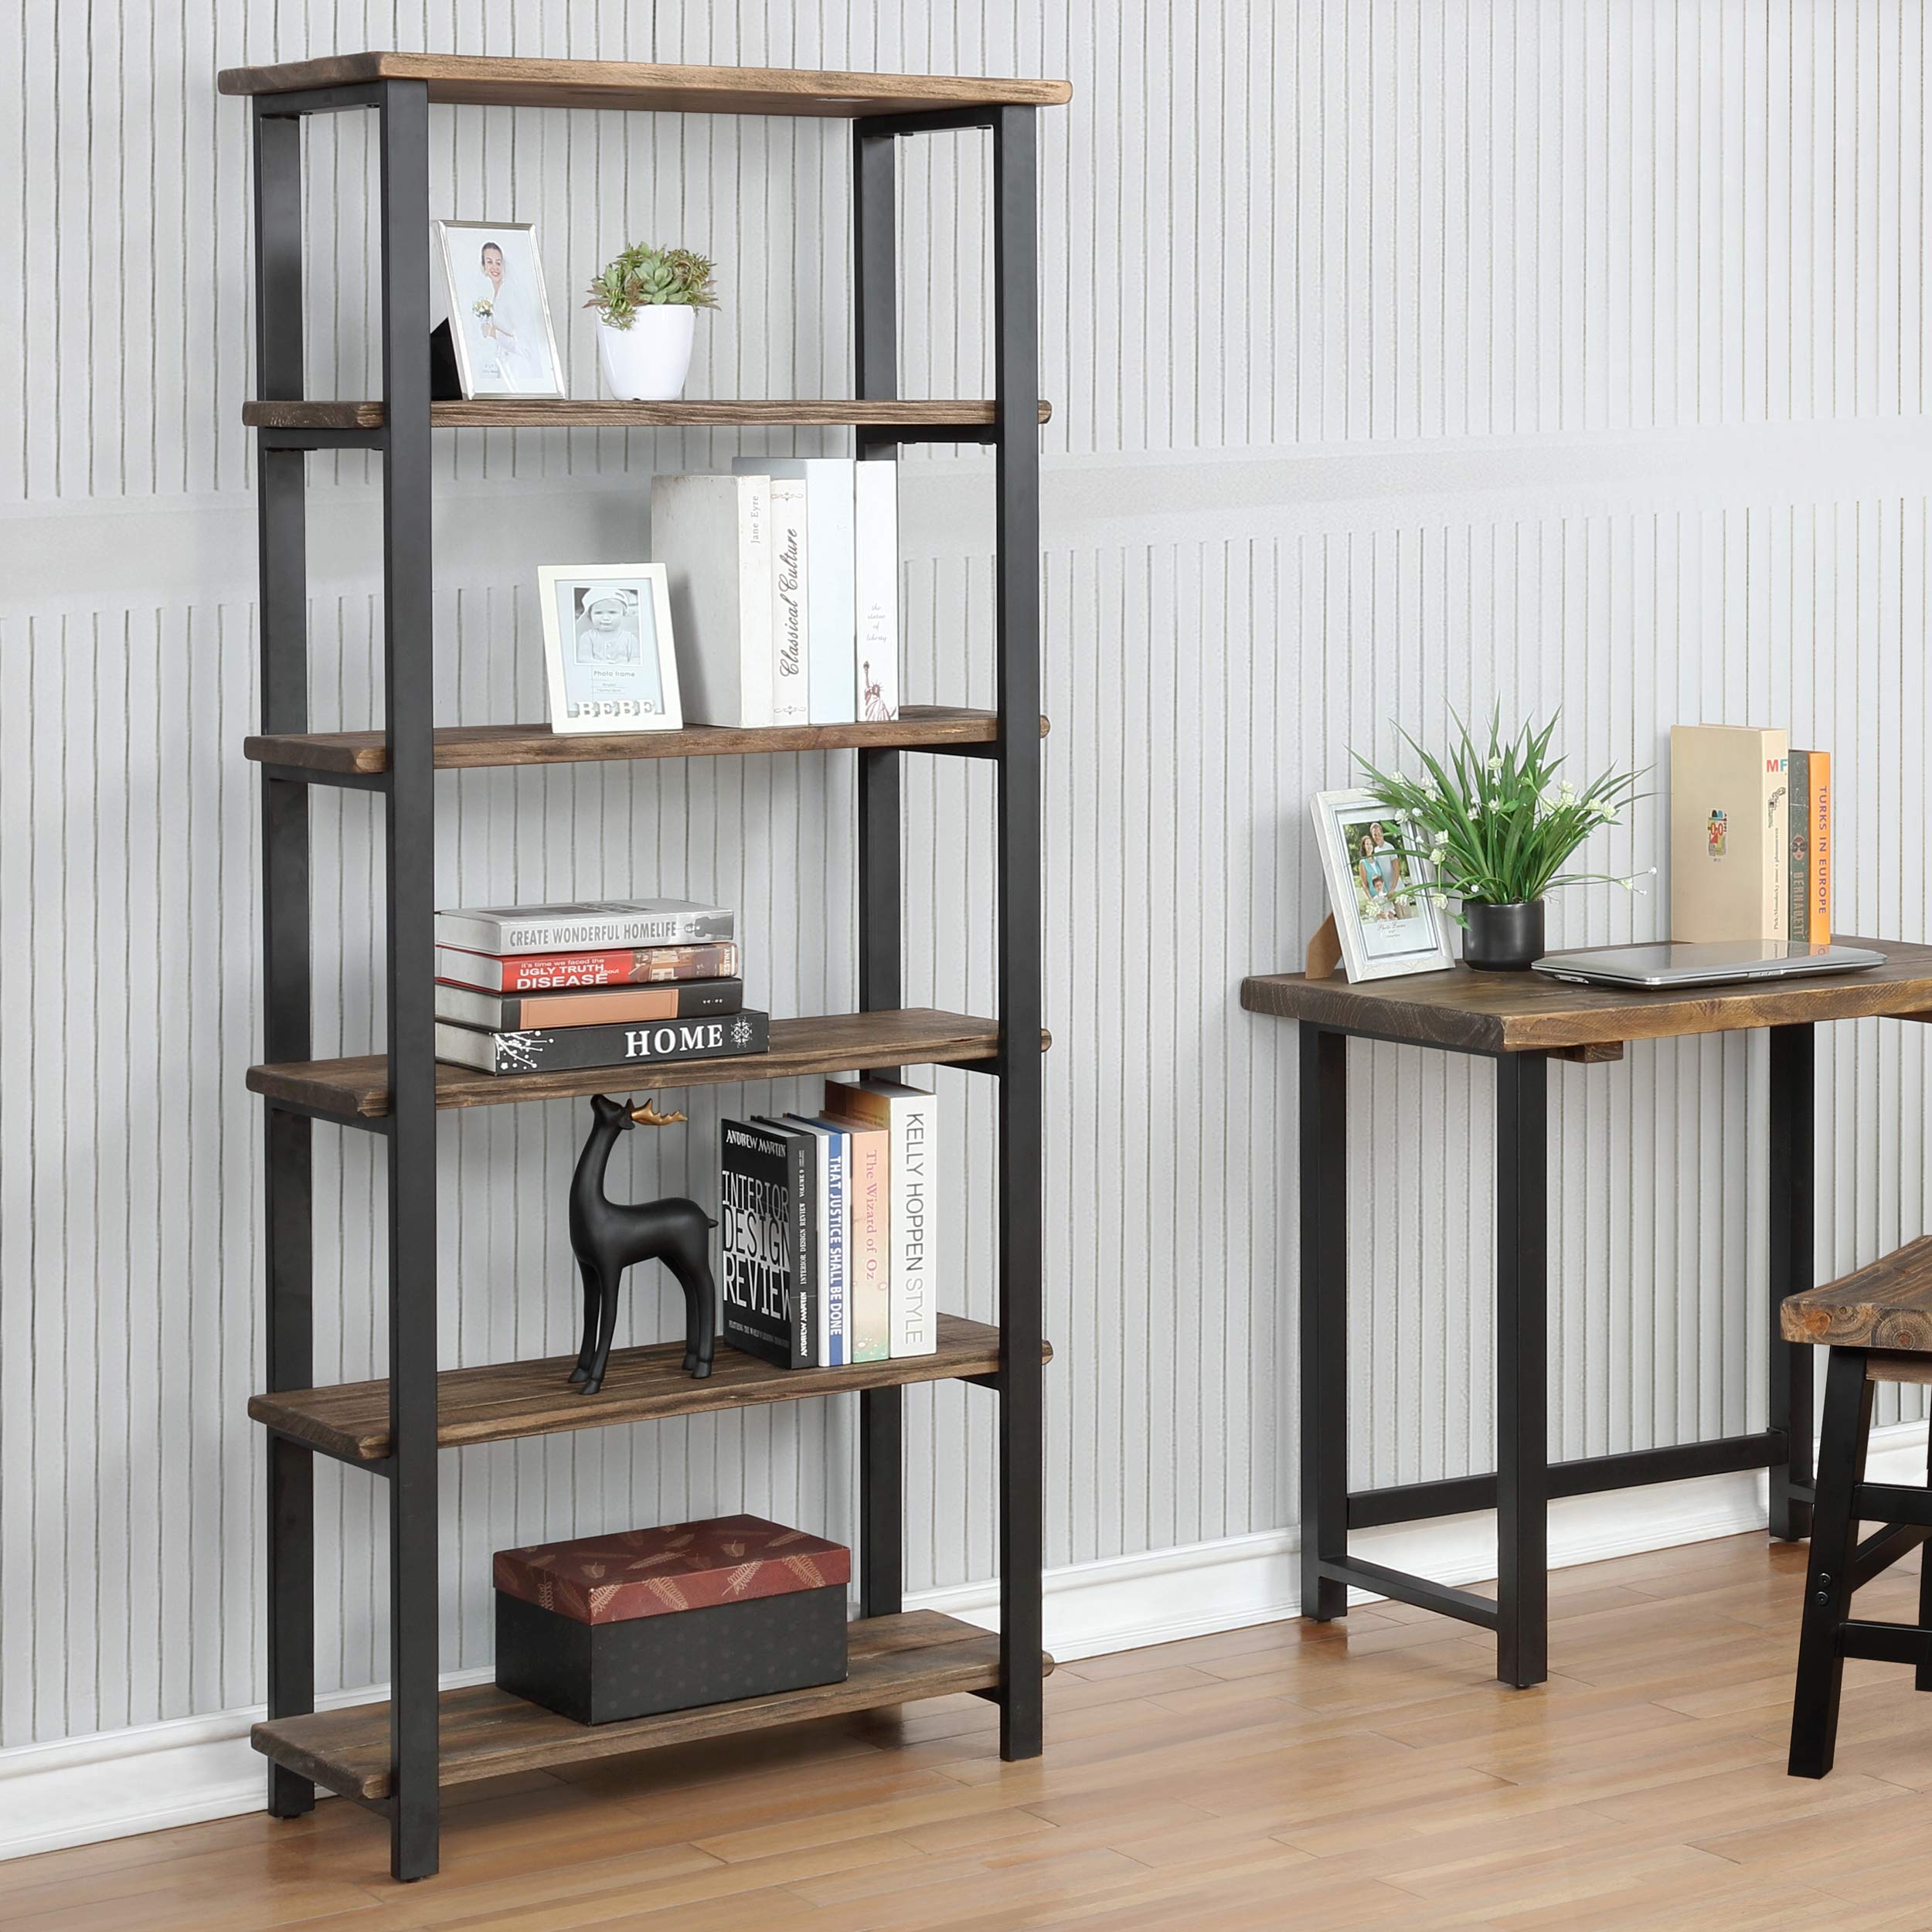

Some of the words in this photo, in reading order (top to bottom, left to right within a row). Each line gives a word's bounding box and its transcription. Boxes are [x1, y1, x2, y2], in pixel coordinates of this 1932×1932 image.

[750, 495, 761, 519] Eyre
[750, 522, 761, 544] Jane
[778, 528, 798, 593] Culture
[779, 593, 799, 677] Classical
[577, 699, 656, 718] BEBE
[1818, 786, 1827, 829] TURKS
[1818, 837, 1826, 852] IN
[510, 929, 549, 947] CREATE
[553, 925, 620, 944] WONDERFUL
[624, 921, 676, 939] HOMELIFE
[517, 974, 608, 989] DISEASE
[519, 968, 556, 976] UGLY
[558, 964, 604, 974] TRUTH
[625, 1023, 724, 1058] HOME
[726, 1129, 758, 1150] ANDREW
[758, 1138, 786, 1157] MARTIN
[906, 1113, 924, 1175] KELLY
[830, 1156, 841, 1189] THAT
[866, 1150, 877, 1179] The
[722, 1170, 790, 1223] INTERIOR
[866, 1183, 877, 1233] Wizard
[830, 1193, 842, 1243] JUSTICE
[906, 1182, 924, 1271] HOPPEN
[723, 1204, 790, 1272] DESIGN
[866, 1236, 877, 1254] of
[830, 1248, 842, 1284] SHALL
[866, 1258, 878, 1281] Oz
[723, 1250, 791, 1322] REVIEW
[830, 1286, 842, 1300] BE
[830, 1303, 842, 1335] DONE
[905, 1278, 923, 1344] STYLE
[800, 1322, 808, 1357] ANDREW
